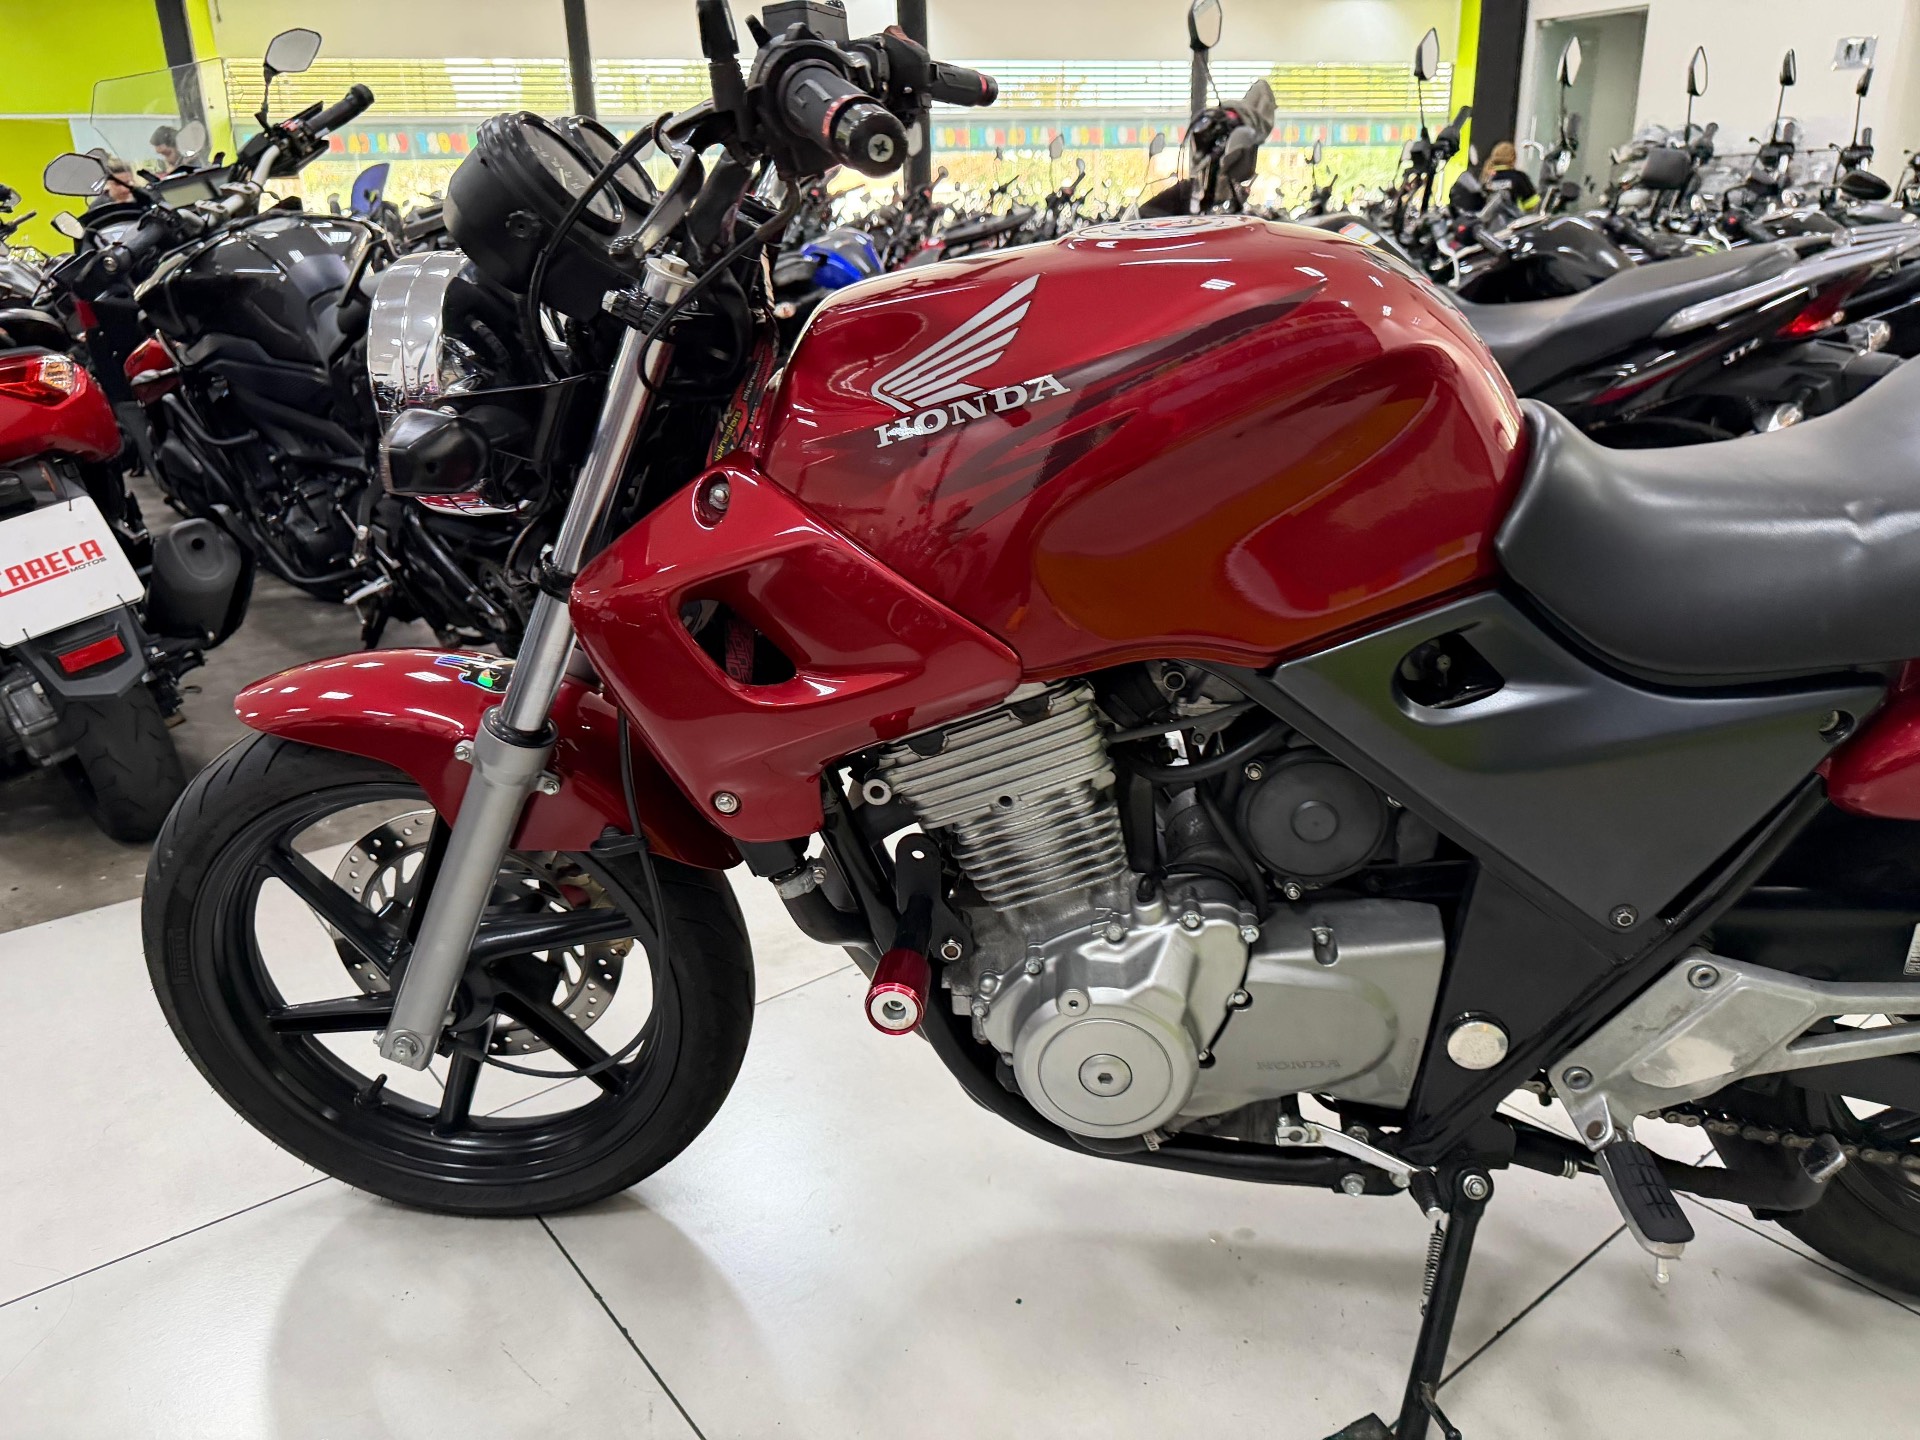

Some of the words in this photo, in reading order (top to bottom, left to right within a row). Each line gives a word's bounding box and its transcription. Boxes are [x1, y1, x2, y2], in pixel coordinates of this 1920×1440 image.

[873, 374, 1071, 448] HONDA
[0, 539, 104, 597] ARECA
[70, 556, 107, 573] MOTOS
[1256, 1059, 1341, 1071] HONDA
